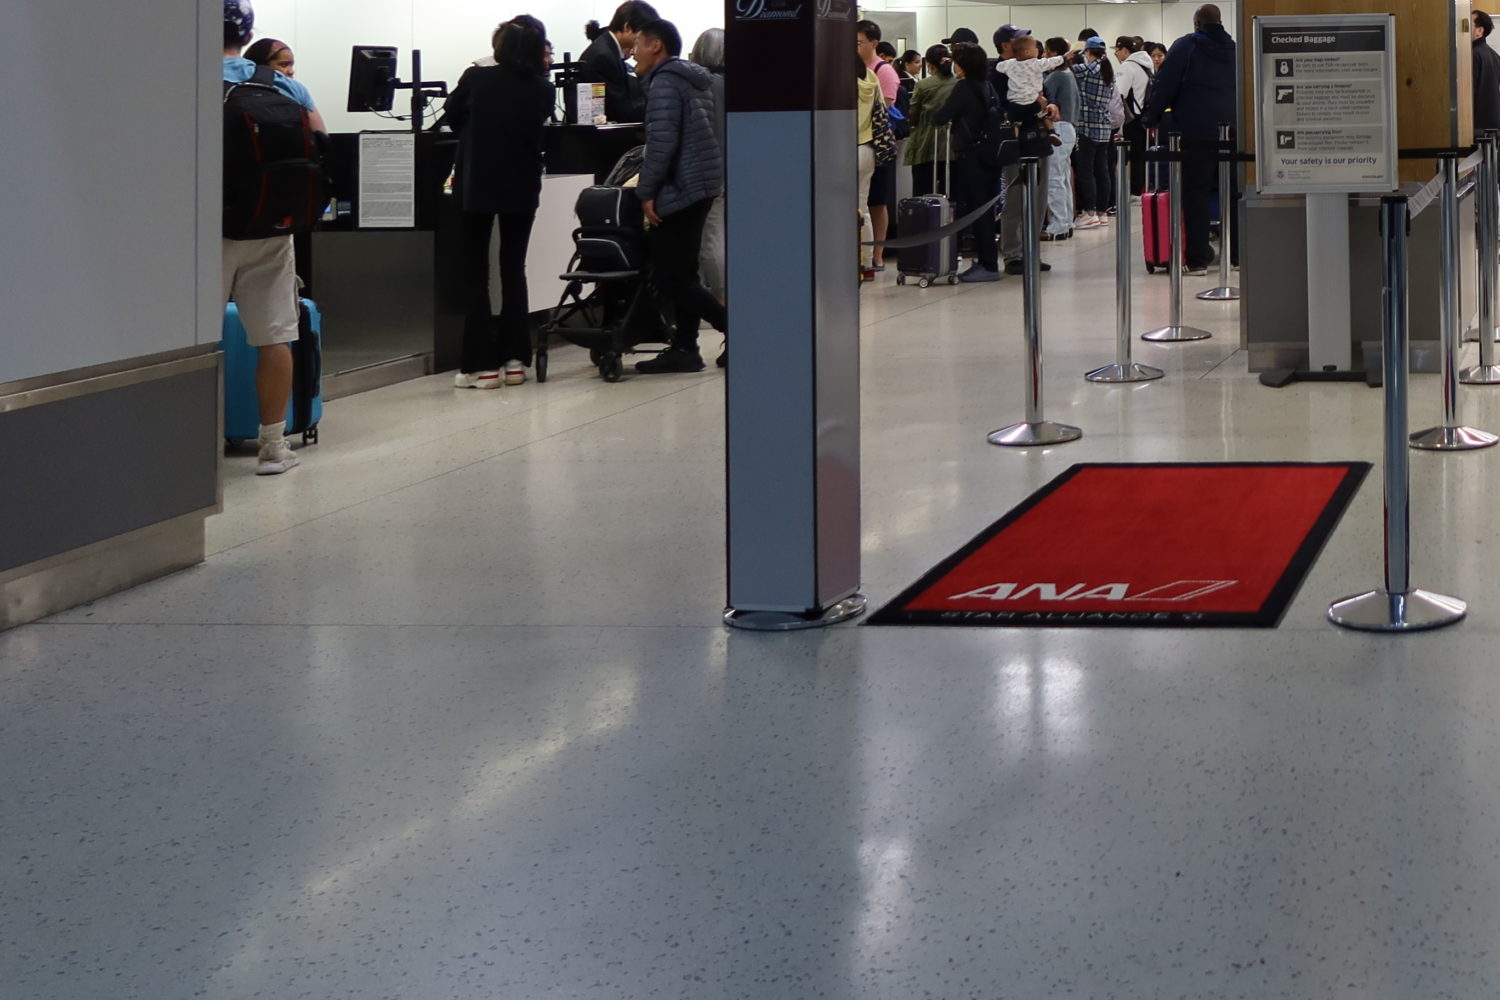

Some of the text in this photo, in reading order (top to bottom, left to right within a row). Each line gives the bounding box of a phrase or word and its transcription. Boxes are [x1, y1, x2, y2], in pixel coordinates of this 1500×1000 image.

[1271, 36, 1336, 44] Checked Baggage
[1281, 157, 1297, 165] Your
[1300, 157, 1322, 166] safety
[1348, 156, 1377, 165] priority
[947, 582, 1130, 600] ANA
[940, 611, 1170, 620] STAR ALLIANCE
